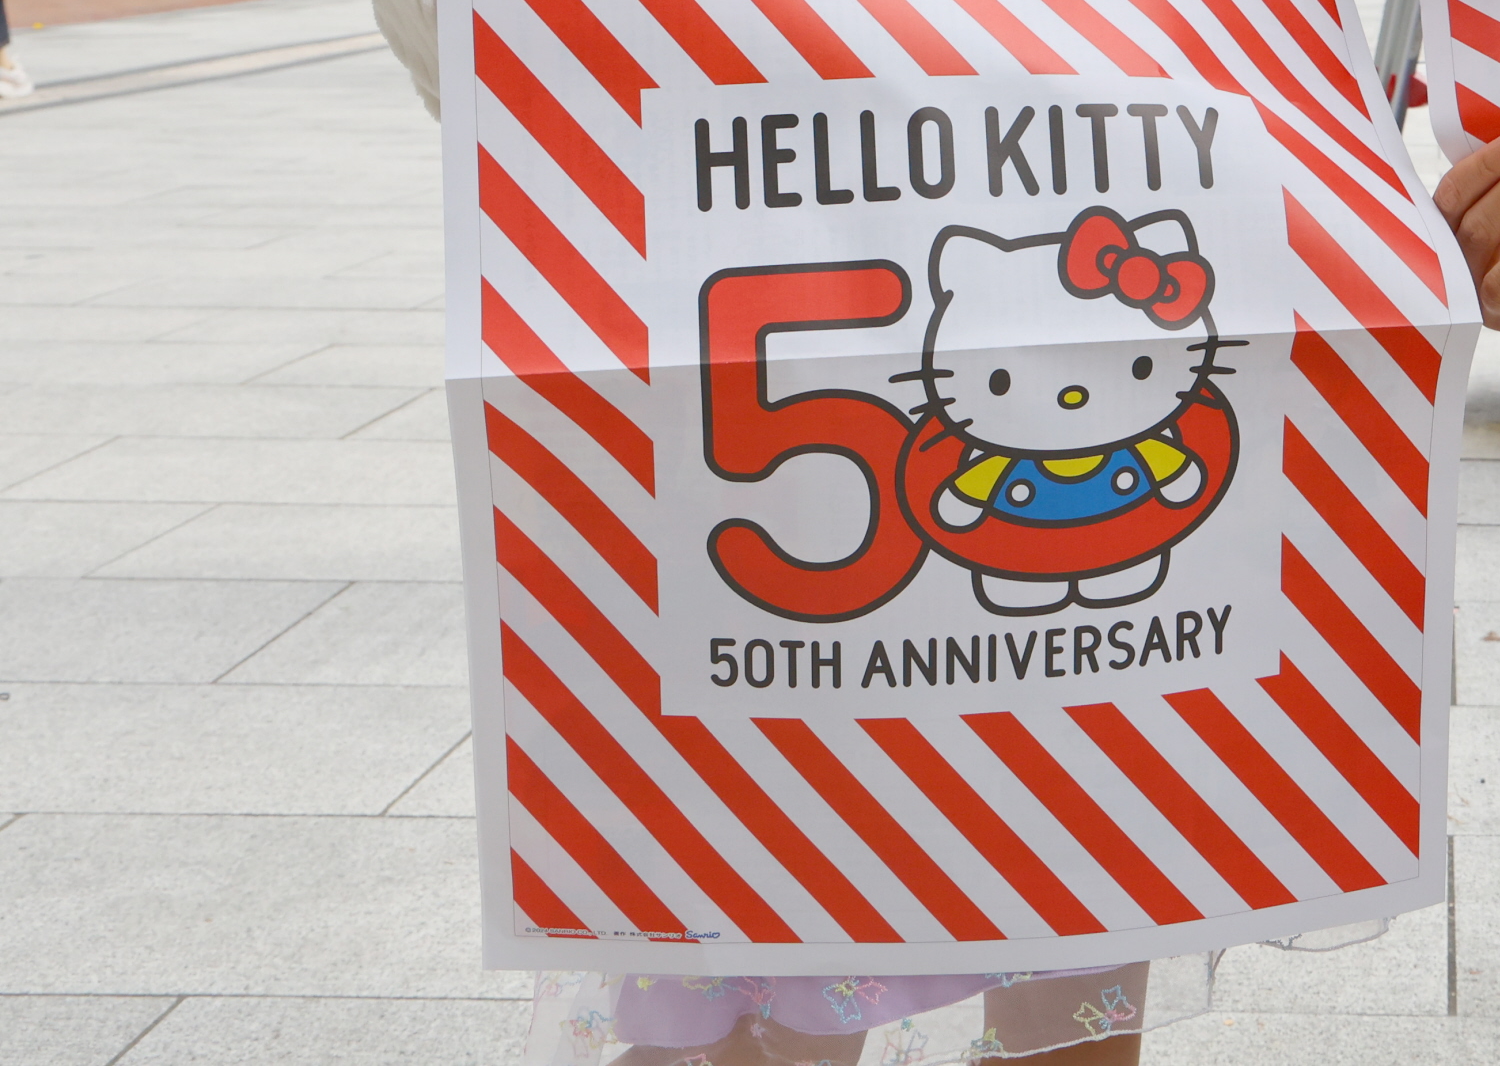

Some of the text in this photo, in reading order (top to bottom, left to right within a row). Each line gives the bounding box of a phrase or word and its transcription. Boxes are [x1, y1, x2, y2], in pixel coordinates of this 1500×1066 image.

[694, 102, 1219, 213] HELLO KITTY
[709, 604, 1232, 690] 50TH ANNIVERSARY
